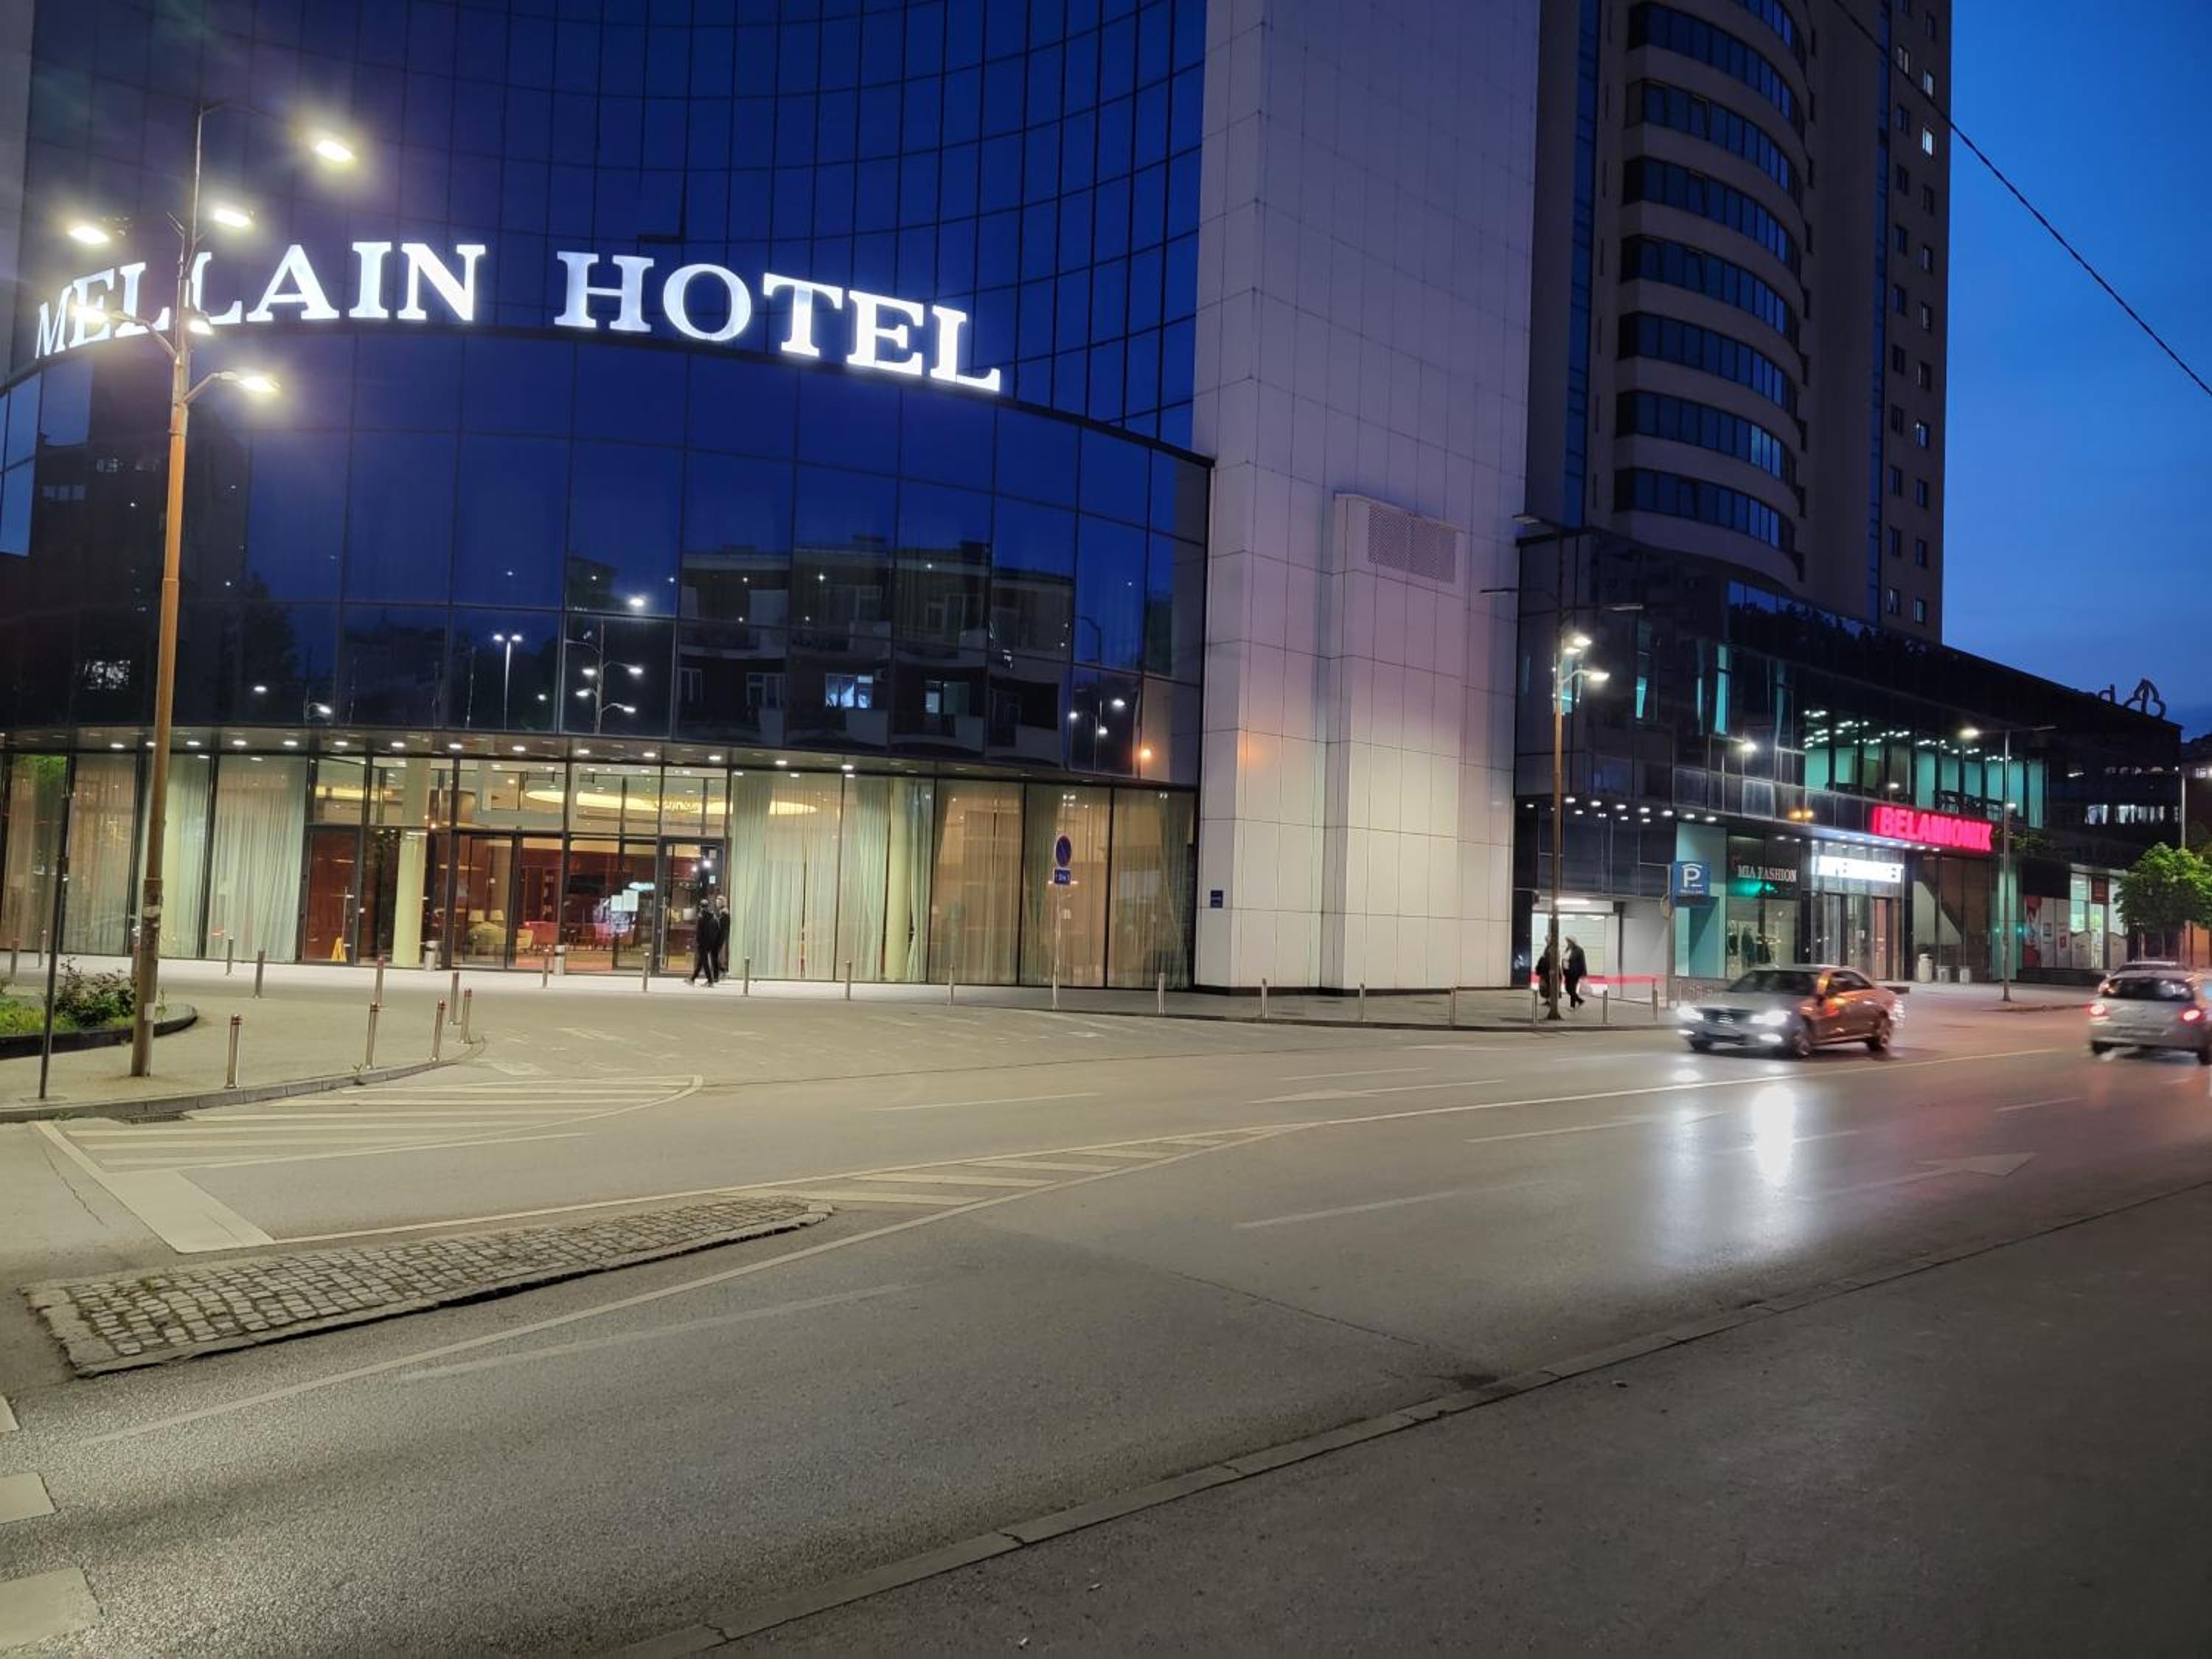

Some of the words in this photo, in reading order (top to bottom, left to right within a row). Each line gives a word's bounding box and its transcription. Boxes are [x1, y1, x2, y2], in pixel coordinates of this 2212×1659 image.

[35, 241, 487, 359] MELLAIN
[554, 251, 1001, 392] HOTEL
[1683, 867, 1701, 888] P
[1758, 866, 1797, 883] FASHION
